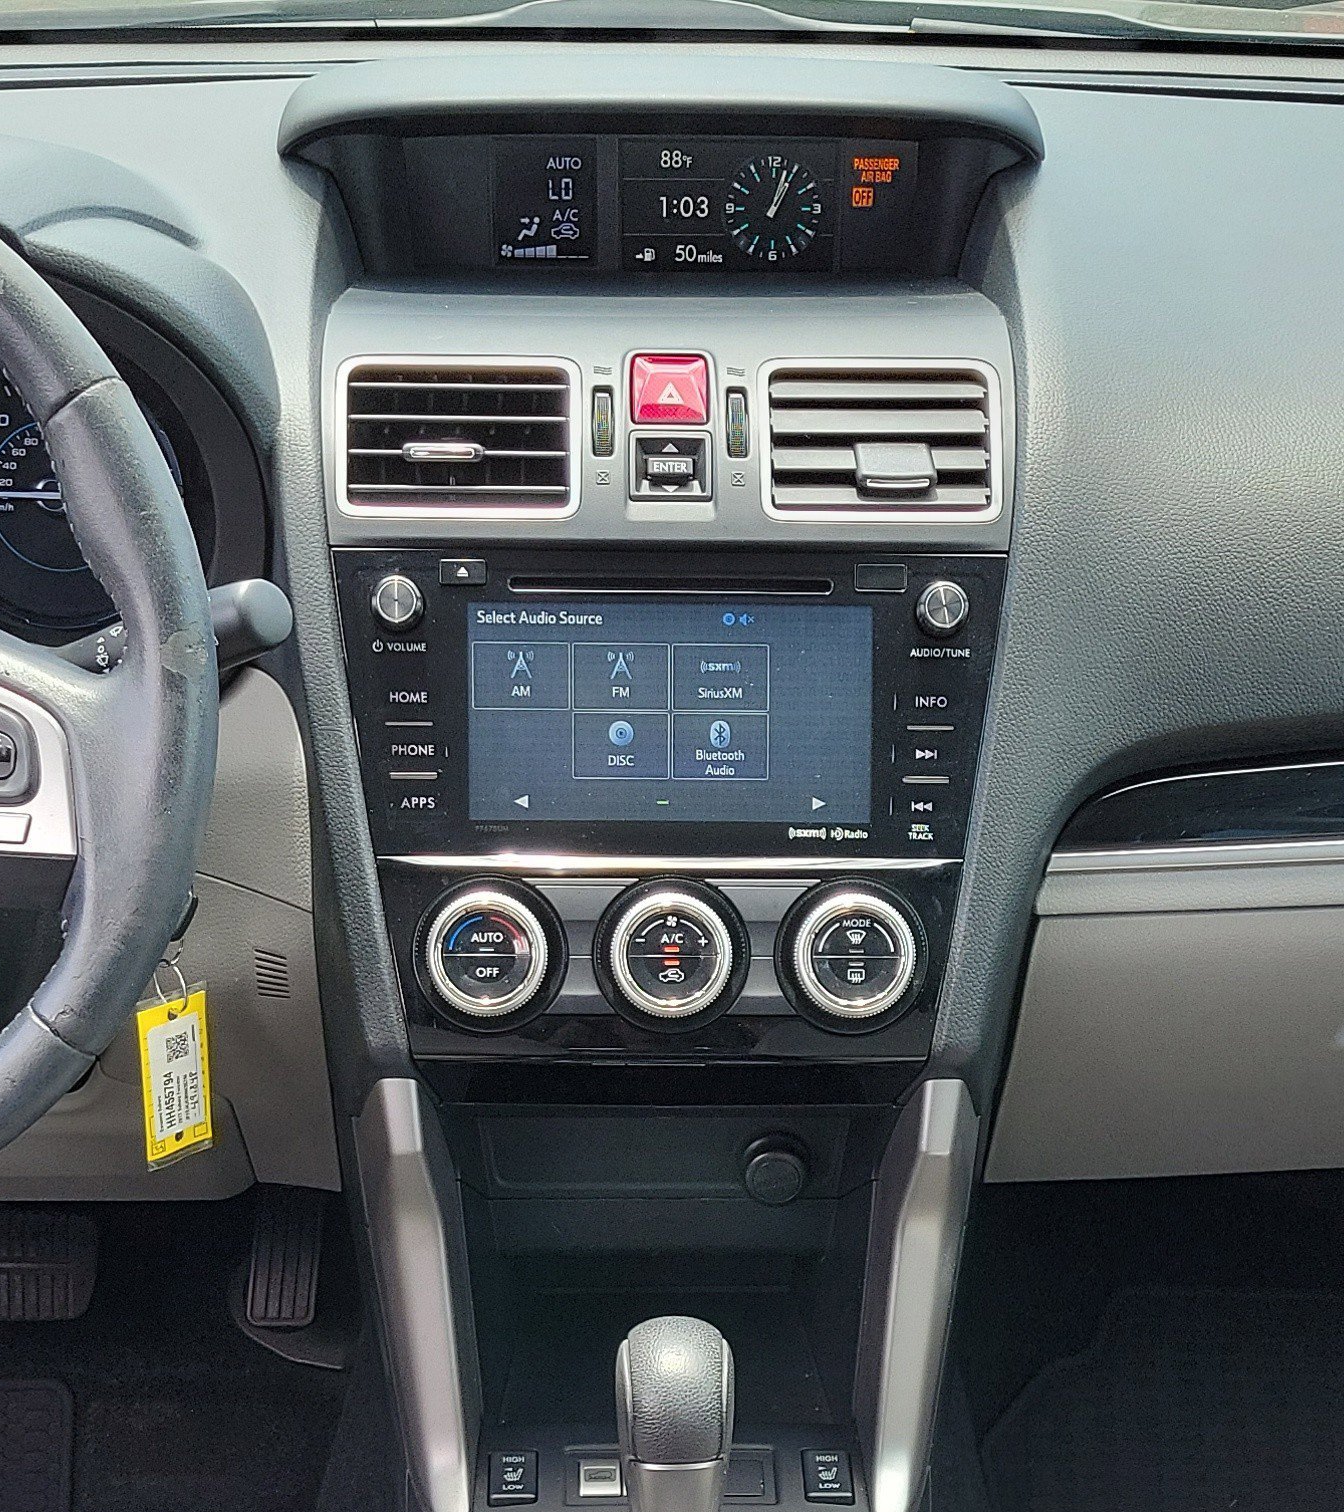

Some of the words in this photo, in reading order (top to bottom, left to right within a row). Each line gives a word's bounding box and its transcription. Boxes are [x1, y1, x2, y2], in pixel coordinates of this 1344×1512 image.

[546, 157, 582, 170] AUTO
[767, 156, 782, 167] 12
[853, 158, 900, 171] PASSENGER
[853, 189, 873, 206] OFF
[659, 196, 709, 218] 1:03
[725, 203, 735, 214] 9
[812, 203, 822, 214] 3
[552, 208, 579, 221] A/C
[674, 244, 697, 262] 50
[697, 250, 723, 263] miles
[767, 250, 777, 261] 6
[23, 437, 39, 446] 80
[11, 448, 26, 457] 60
[1, 462, 17, 470] 40
[653, 461, 687, 473] ENTER
[476, 610, 516, 625] Select
[519, 611, 557, 625] Audio
[559, 611, 603, 625] Source
[386, 642, 427, 651] VOLUME
[909, 648, 971, 658] AUDIO/TUNE
[511, 685, 531, 697] AM
[612, 687, 630, 698] FM
[697, 687, 743, 699] SiriusXM
[389, 691, 428, 703] HOME
[915, 696, 948, 708] INFO
[391, 744, 435, 756] PHONE
[695, 750, 745, 761] Bluetooth
[608, 755, 634, 766] DISC
[705, 765, 735, 776] Audio
[400, 797, 436, 809] APPS
[844, 829, 869, 839] Radio
[908, 831, 934, 841] TRACK
[842, 918, 872, 928] MODE
[470, 932, 504, 943] AUTO
[660, 933, 684, 944] A/C
[475, 967, 500, 978] OFF
[163, 1071, 177, 1129] HH455794
